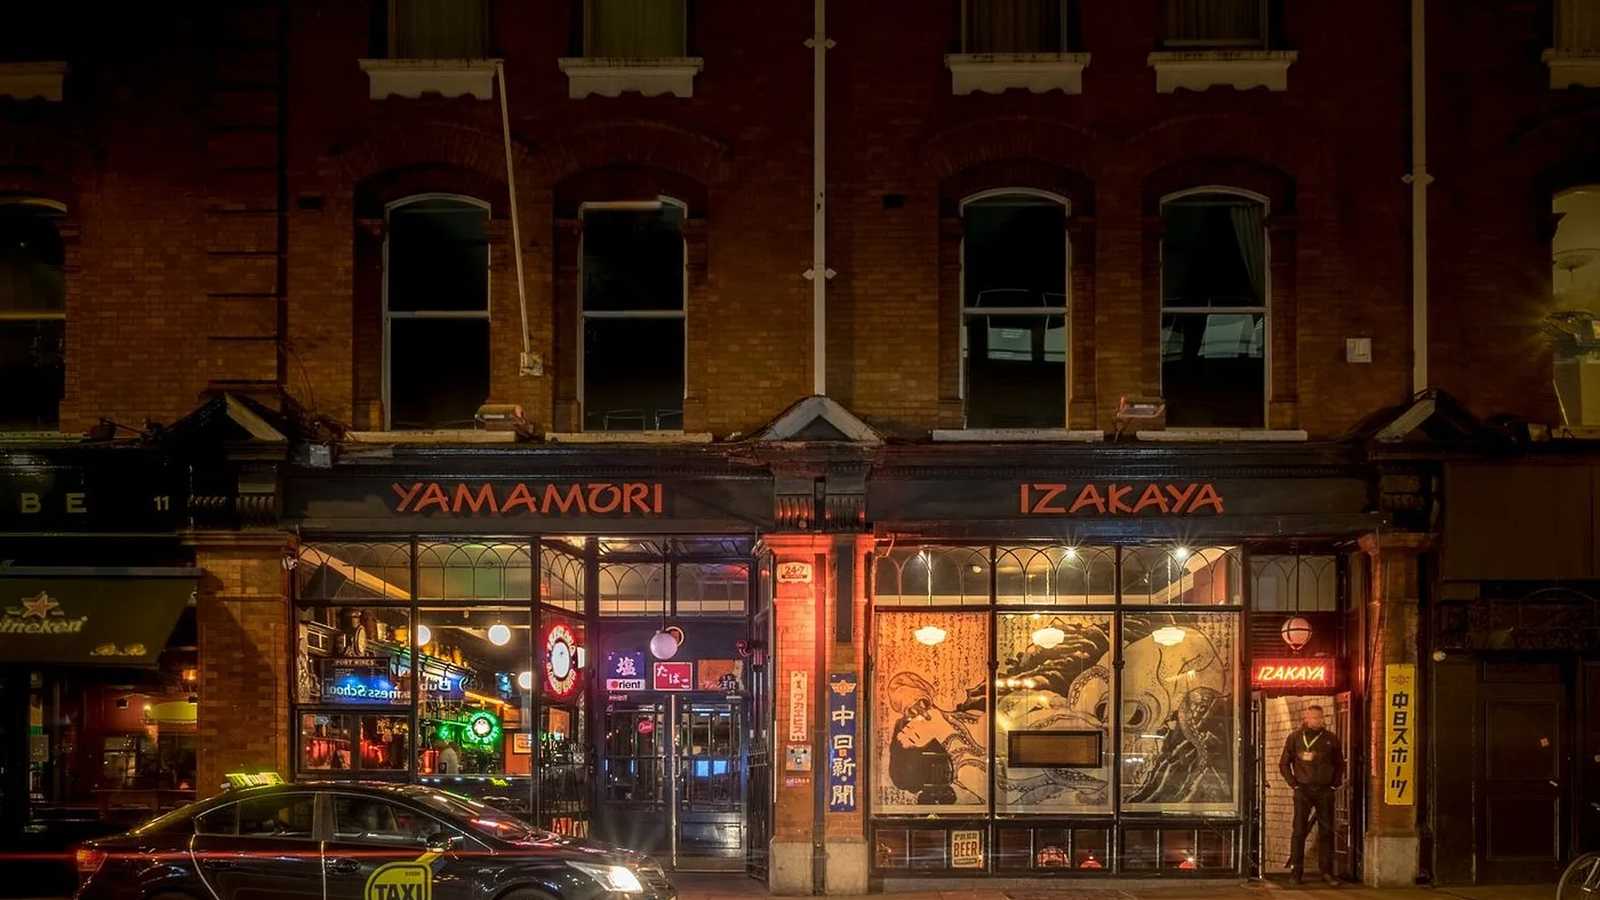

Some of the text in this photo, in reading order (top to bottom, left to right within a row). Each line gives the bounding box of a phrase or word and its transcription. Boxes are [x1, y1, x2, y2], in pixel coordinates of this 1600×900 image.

[153, 495, 170, 511] 11
[392, 483, 662, 513] YAMAMORI
[1020, 483, 1224, 514] IZAKAYA
[0, 616, 83, 634] ineken
[616, 656, 636, 676] 塩
[1258, 665, 1325, 681] IZAKAYA
[830, 704, 856, 807] 中日新聞
[954, 841, 978, 857] BEER
[374, 883, 422, 900] TAXI
